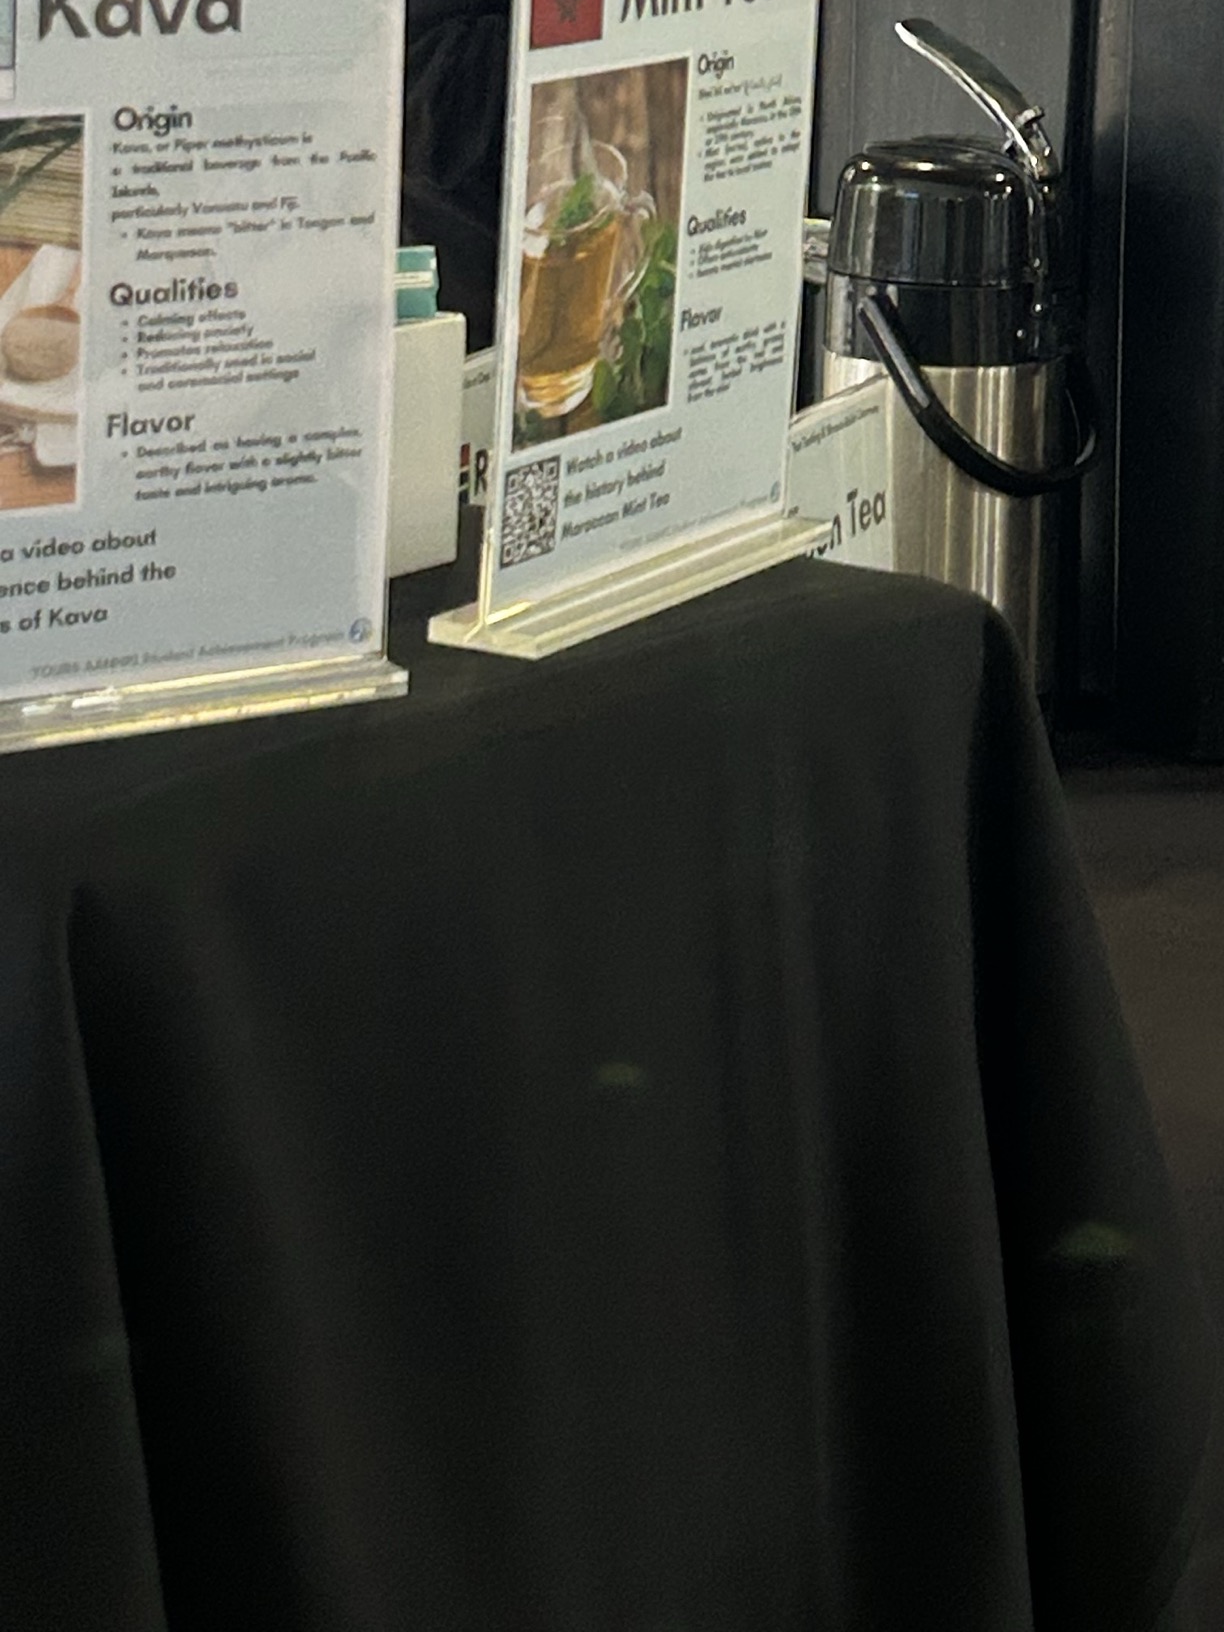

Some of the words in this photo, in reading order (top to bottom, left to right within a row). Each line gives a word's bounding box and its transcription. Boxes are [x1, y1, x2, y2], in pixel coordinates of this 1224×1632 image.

[698, 49, 735, 79] Origin
[114, 104, 193, 137] Origin
[687, 206, 747, 237] Qualities
[110, 277, 239, 306] Qualities
[680, 305, 723, 332] Flavor
[106, 412, 196, 438] Flavor
[846, 487, 886, 537] Tea
[0, 548, 15, 562] a
[23, 537, 86, 559] video
[91, 528, 157, 552] about
[57, 565, 135, 591] behind
[141, 561, 177, 583] the
[19, 609, 42, 632] of
[49, 606, 109, 628] Kava
